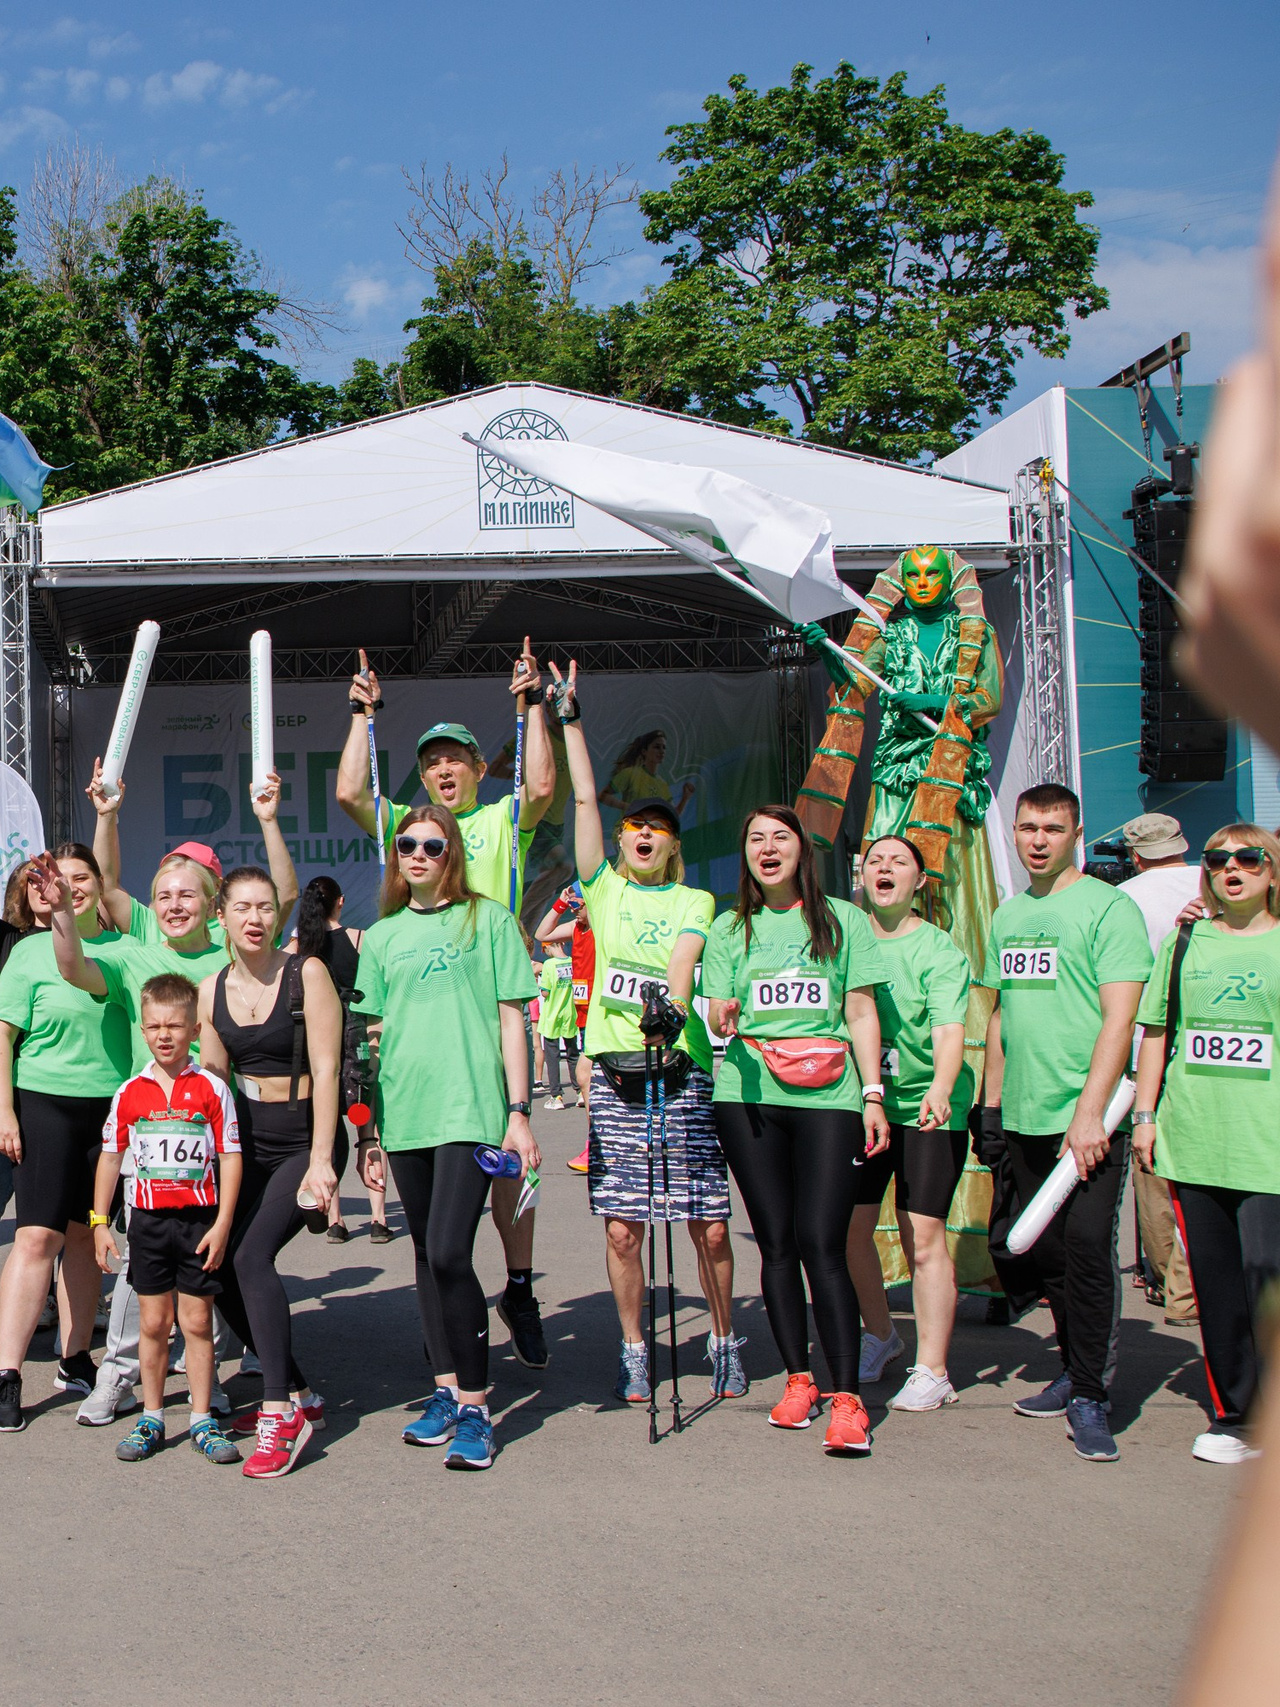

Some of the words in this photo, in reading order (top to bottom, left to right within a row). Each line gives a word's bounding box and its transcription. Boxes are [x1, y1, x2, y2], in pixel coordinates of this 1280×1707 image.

[132, 664, 144, 689] СБЕР
[112, 689, 137, 760] СТРАХОВАНИЕ
[276, 715, 307, 727] БЕР
[514, 755, 522, 785] CMD
[165, 839, 382, 867] СТОЯЩИМ
[1003, 952, 1051, 974] 0815
[573, 986, 585, 998] 47
[759, 982, 821, 1005] 0878
[1192, 1035, 1263, 1062] 0822
[159, 1139, 204, 1164] 164
